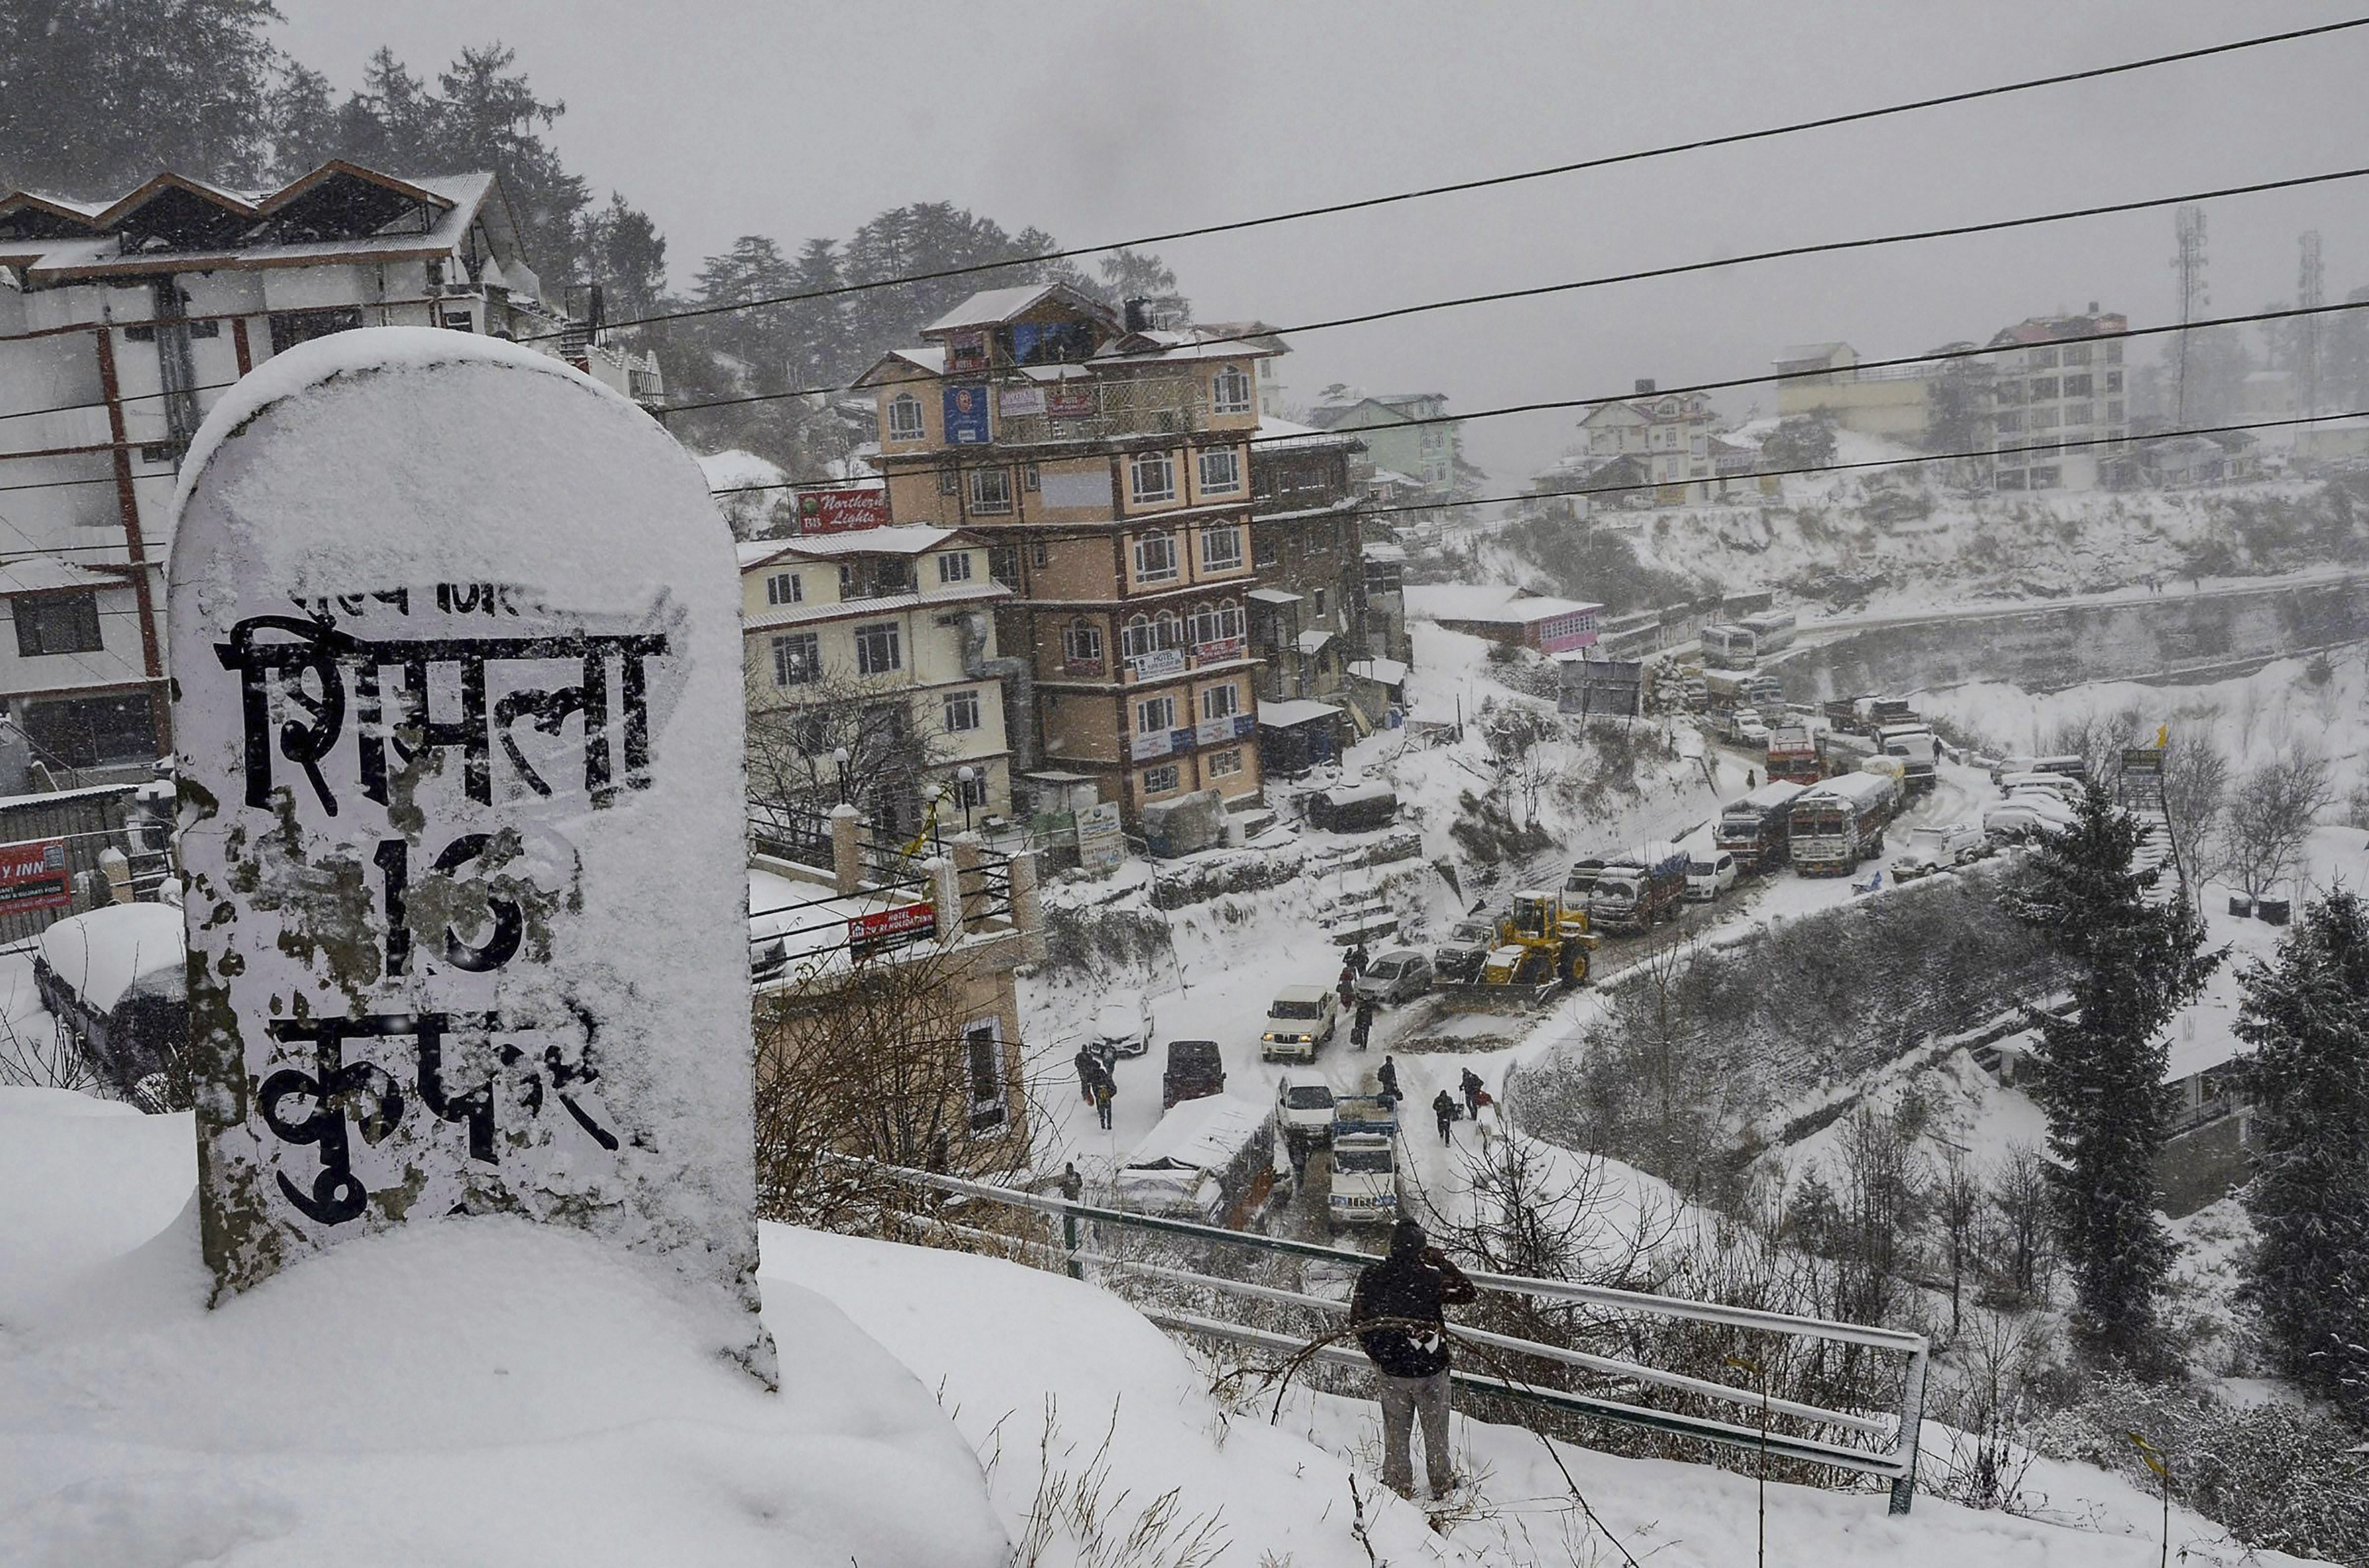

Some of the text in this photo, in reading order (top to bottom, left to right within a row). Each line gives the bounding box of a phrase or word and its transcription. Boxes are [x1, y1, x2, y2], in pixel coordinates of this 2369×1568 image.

[821, 494, 885, 510] Northern
[830, 510, 874, 527] Lights
[1153, 652, 1175, 664] HOTEL
[213, 615, 668, 818] शिमला
[16, 861, 44, 876] INN
[888, 911, 910, 921] HOTEL
